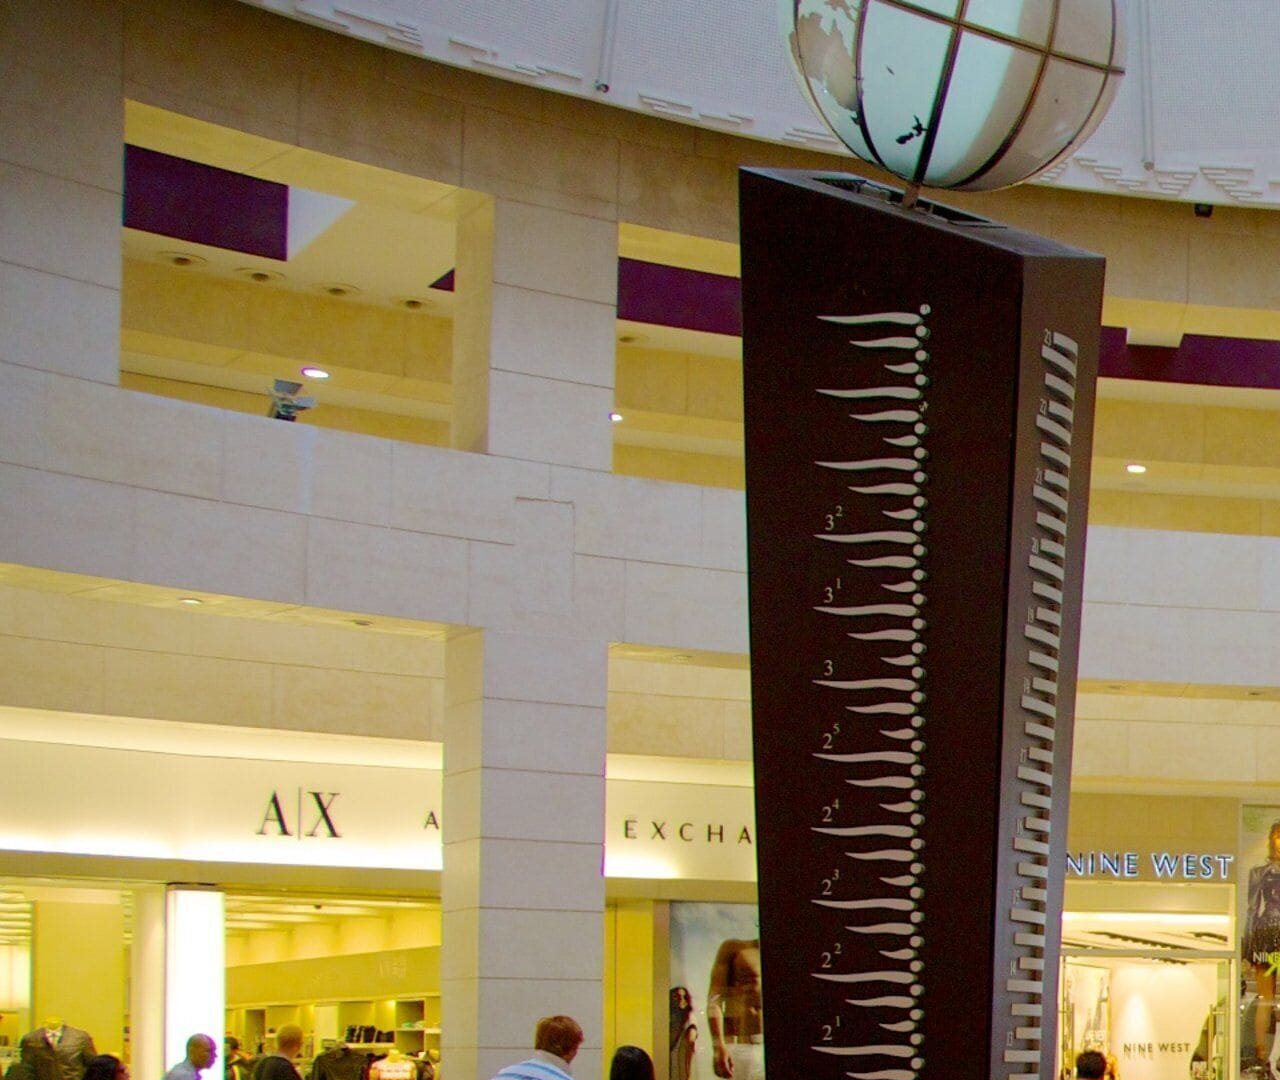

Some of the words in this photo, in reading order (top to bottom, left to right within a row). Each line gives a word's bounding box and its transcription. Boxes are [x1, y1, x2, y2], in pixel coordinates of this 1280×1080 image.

[624, 819, 752, 845] EXCHA
[1066, 851, 1141, 876] NINE
[1151, 852, 1234, 878] WEST
[1123, 1042, 1153, 1053] NINE
[1158, 1042, 1190, 1053] WEST
